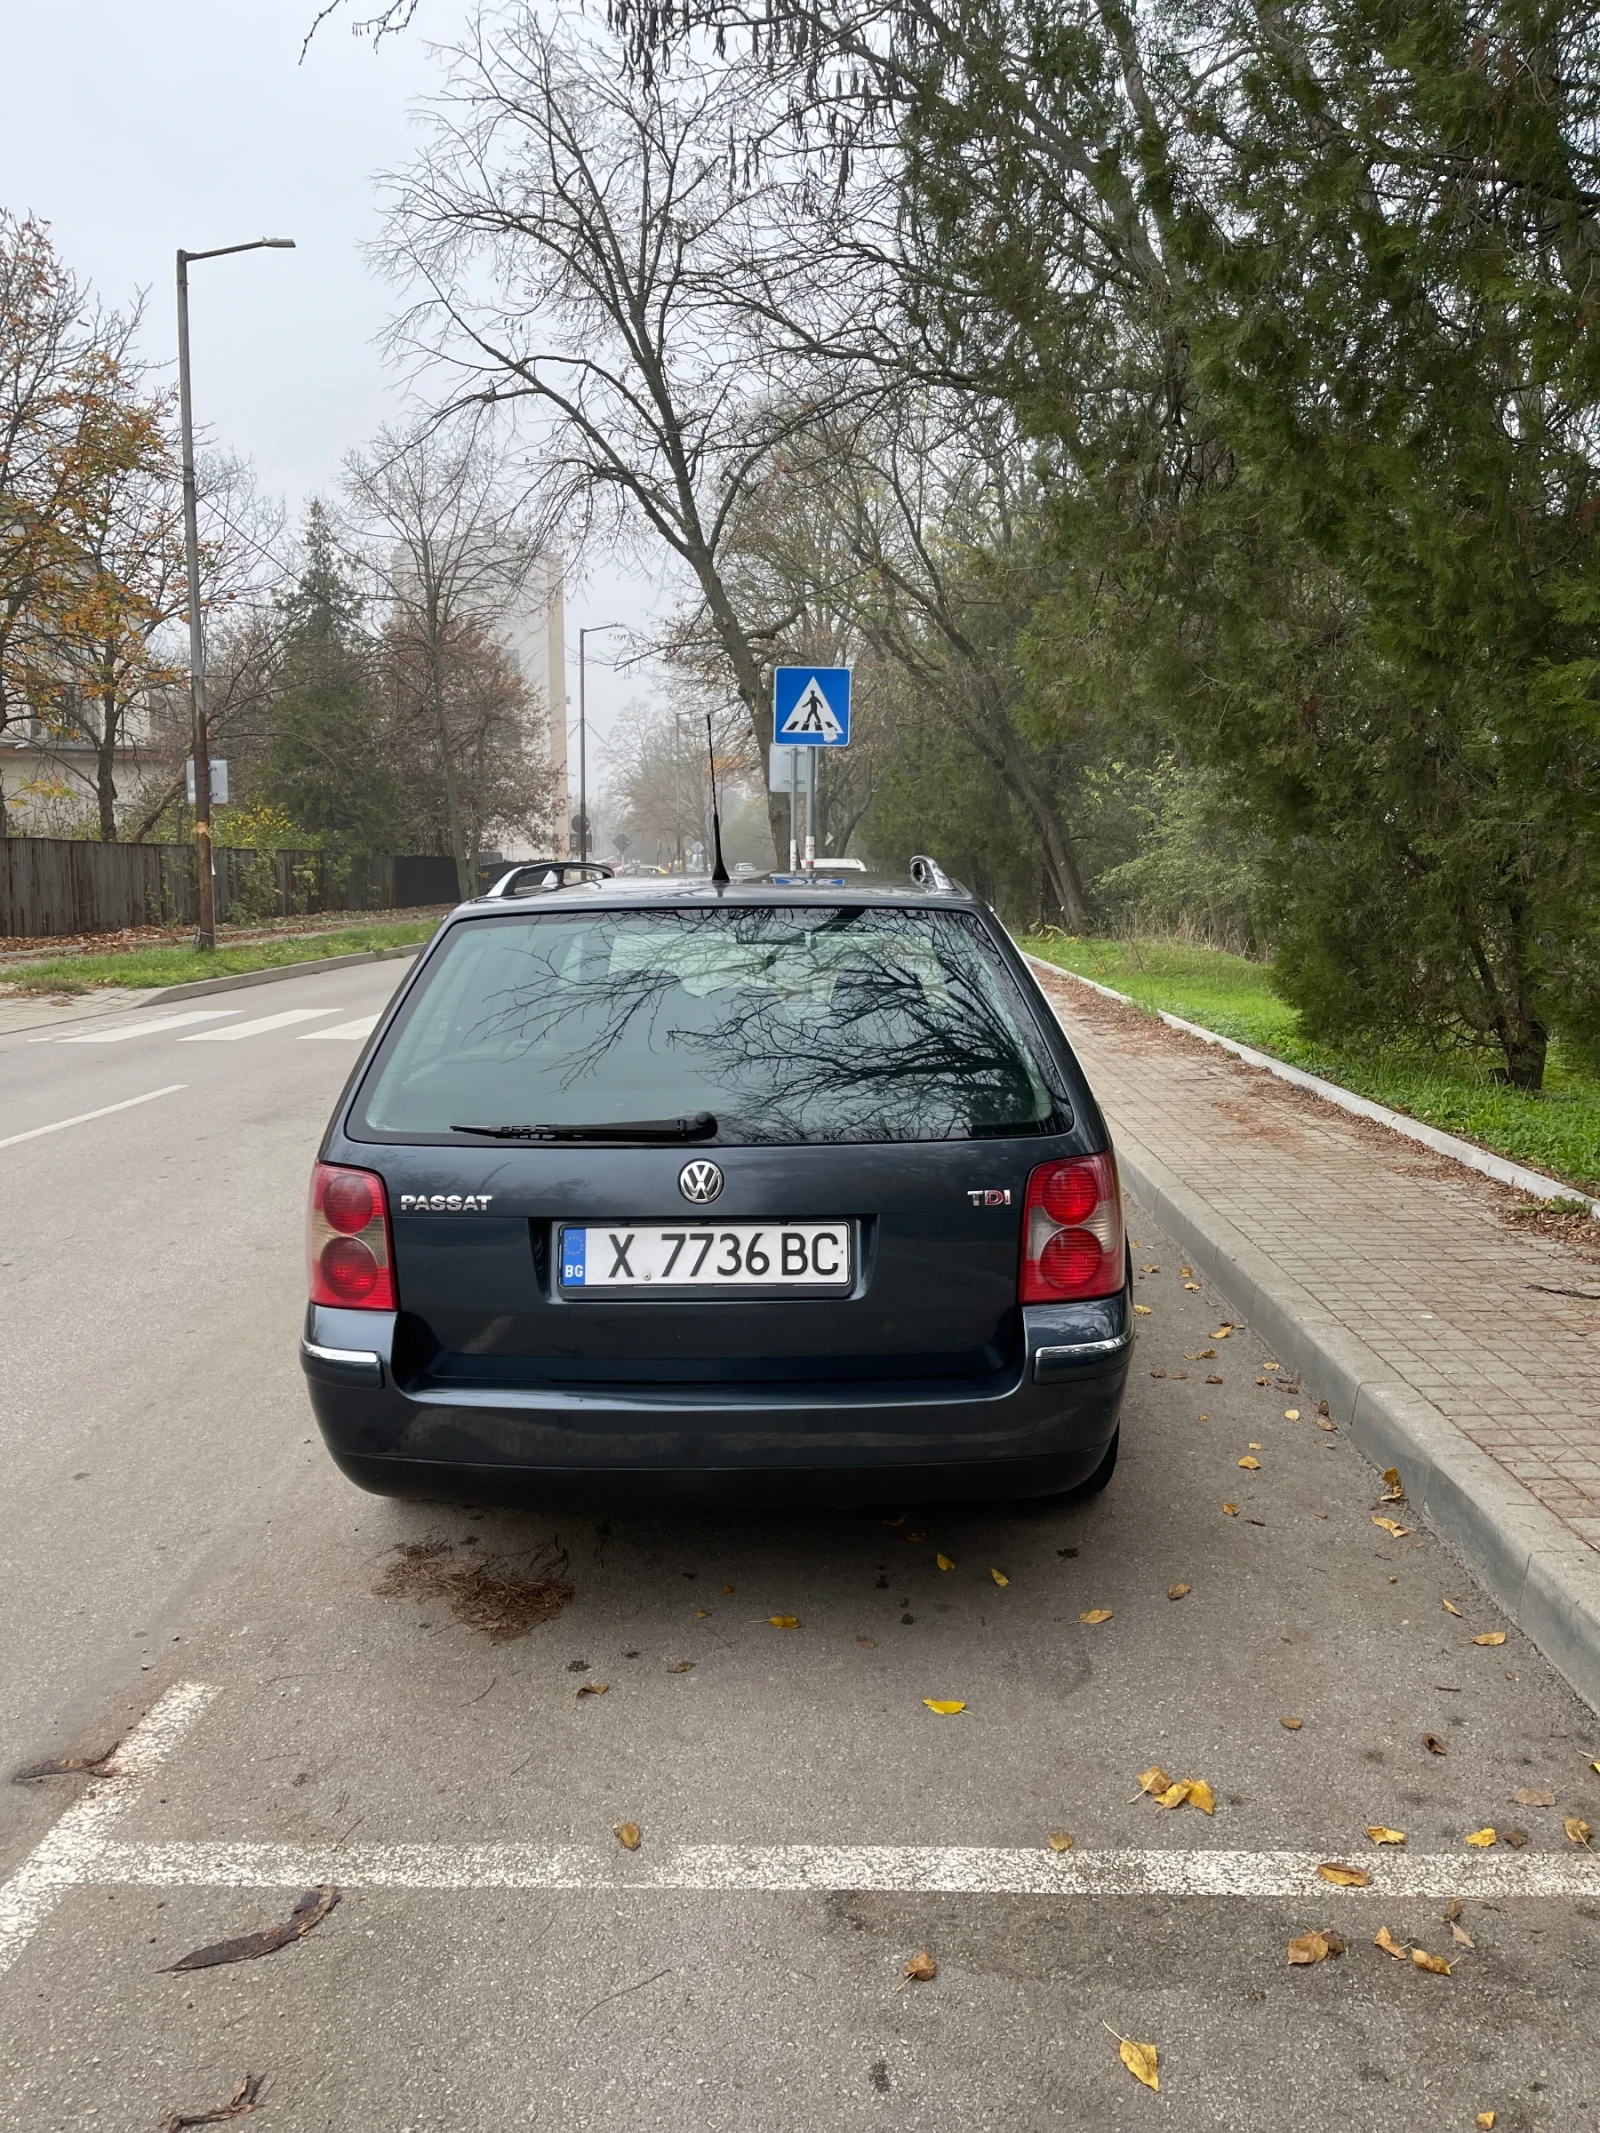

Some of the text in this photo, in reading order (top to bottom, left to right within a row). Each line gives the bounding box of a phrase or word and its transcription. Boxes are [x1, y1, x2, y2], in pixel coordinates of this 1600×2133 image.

[680, 1160, 722, 1203] VW
[401, 1195, 493, 1211] PASSAT
[967, 1189, 1011, 1206] TDI
[608, 1231, 839, 1278] X 7736 BC
[564, 1264, 584, 1278] BG
